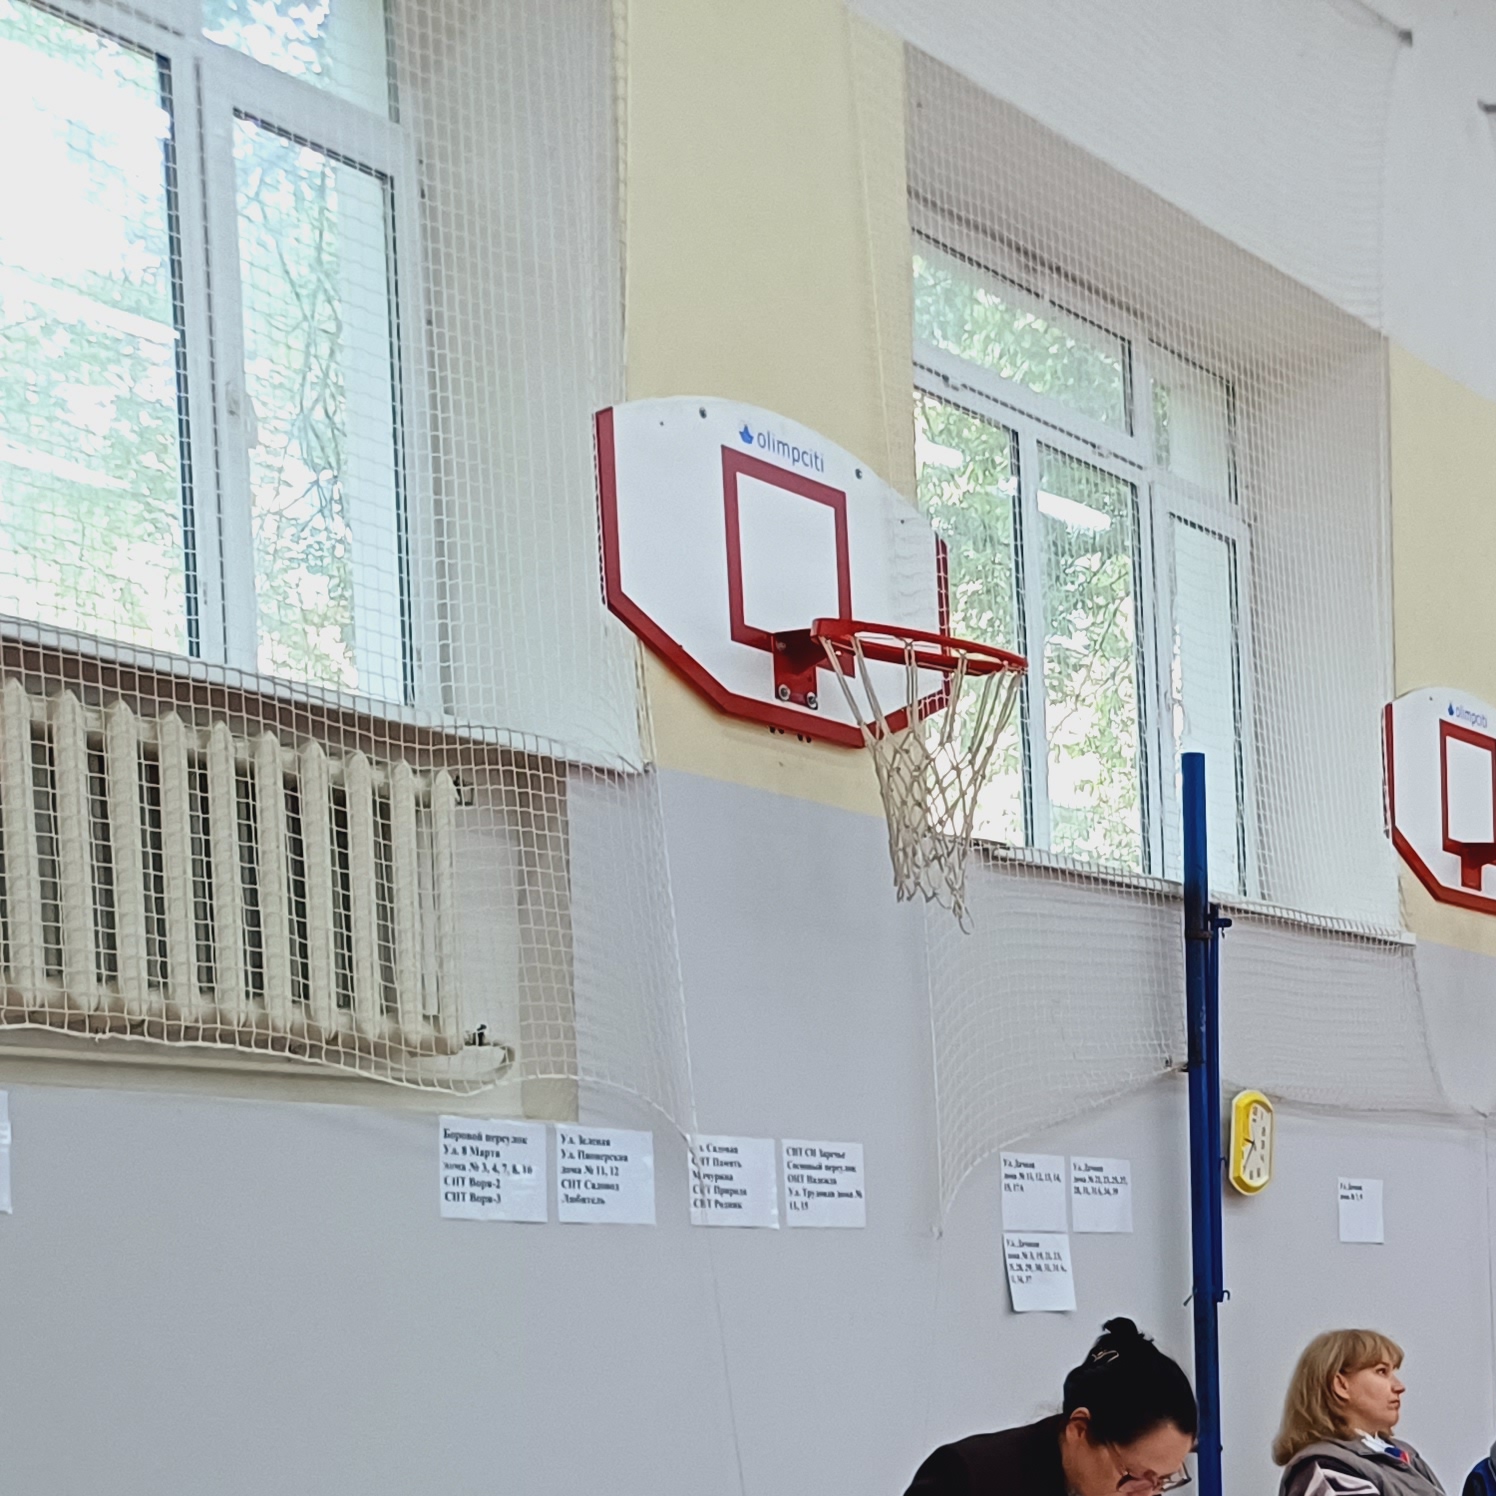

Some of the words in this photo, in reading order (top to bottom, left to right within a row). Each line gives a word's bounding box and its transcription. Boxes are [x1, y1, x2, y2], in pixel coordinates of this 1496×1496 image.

[757, 430, 824, 473] olimpciti
[443, 1128, 483, 1142] Боровой
[485, 1133, 528, 1146] переулок
[469, 1145, 501, 1160] Марта
